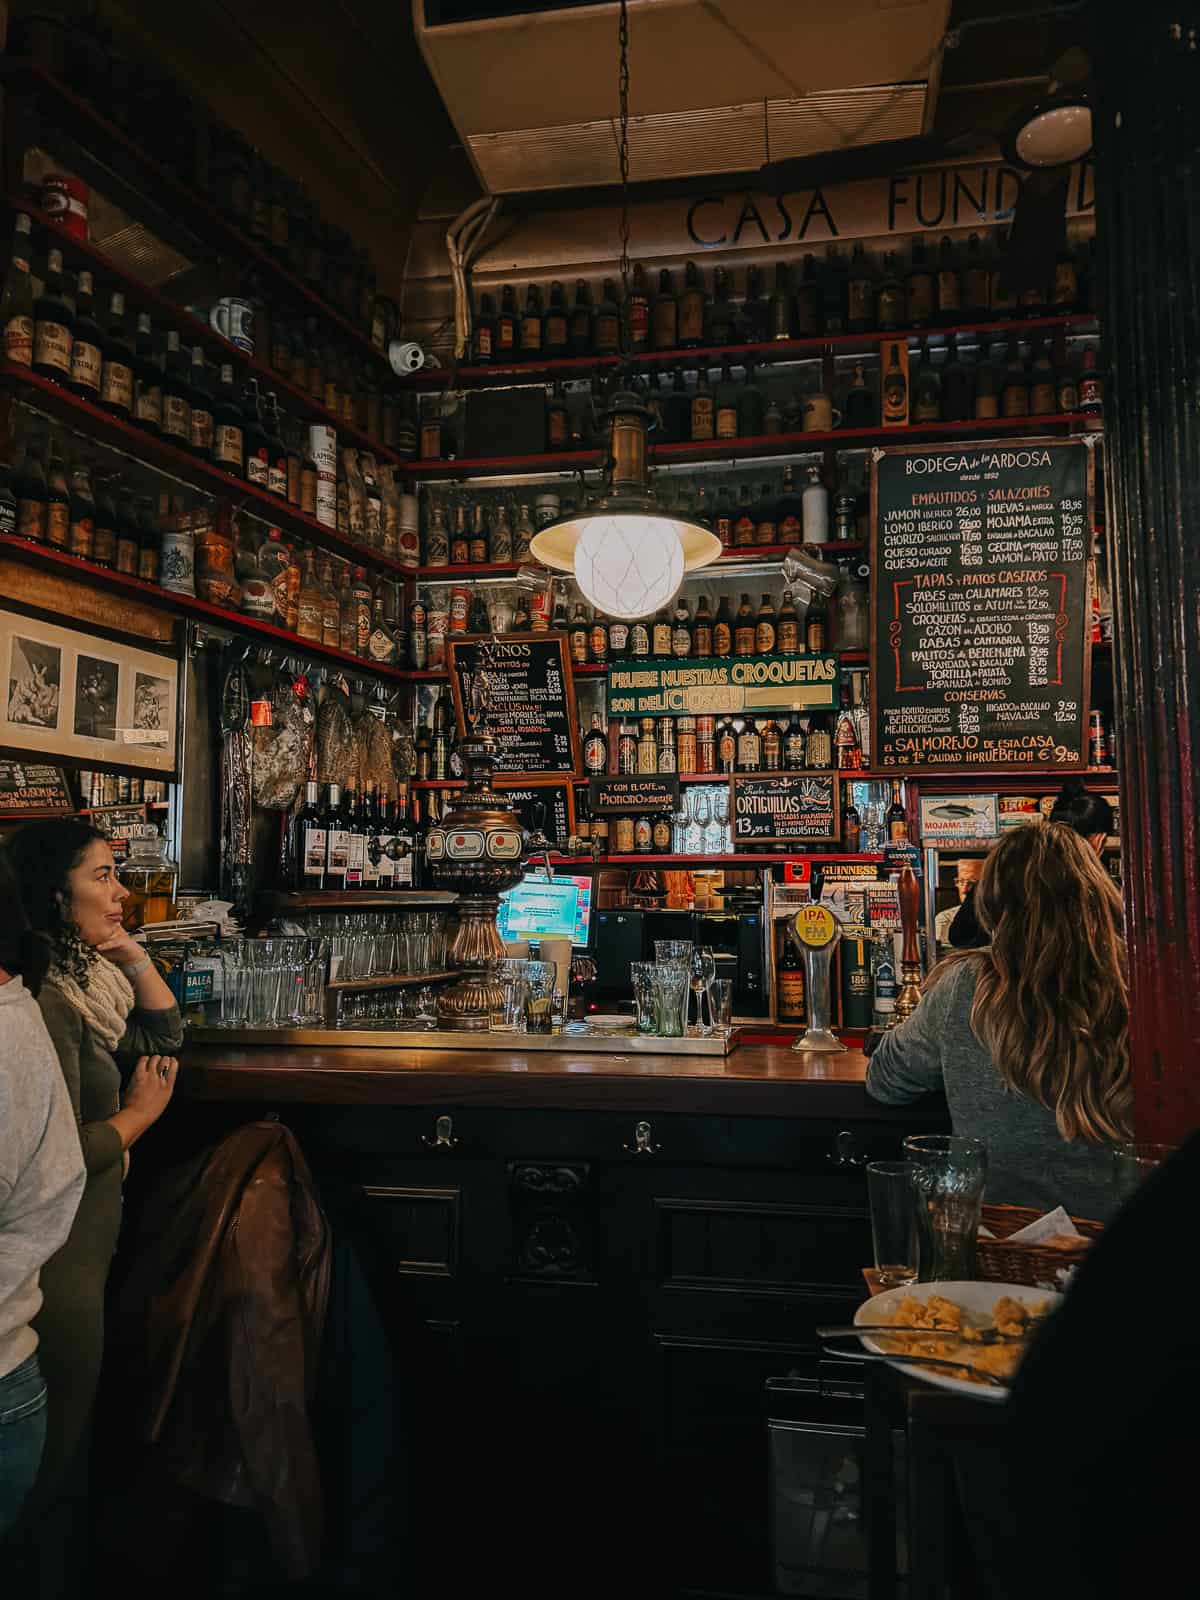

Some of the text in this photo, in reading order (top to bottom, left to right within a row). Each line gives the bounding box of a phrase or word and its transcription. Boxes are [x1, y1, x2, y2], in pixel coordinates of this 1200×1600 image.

[686, 187, 840, 248] CASA
[905, 456, 970, 475] BODEGA
[989, 451, 1053, 469] ARDOSA
[911, 490, 978, 506] EMBUTIDOS
[987, 485, 1051, 501] SALAZONES
[884, 509, 921, 521] JAMON
[986, 502, 1025, 515] HUEVAS
[884, 521, 915, 535] LOMO
[918, 519, 953, 532] IBERICO
[986, 515, 1033, 529] MOJAMA
[884, 533, 924, 546] CHORIZO
[1018, 527, 1055, 539] BACALAO
[884, 548, 918, 559] QUESO
[919, 546, 952, 557] CURADO
[987, 541, 1023, 553] CECINA
[884, 558, 920, 570] QUESO
[926, 557, 949, 567] ACEITE
[988, 551, 1024, 564] JAMON
[1032, 550, 1058, 562] PATO
[913, 573, 954, 588] TAPAS
[962, 574, 996, 586] PLATOS
[997, 570, 1048, 583] CASEROS
[912, 590, 947, 603] FABES
[965, 587, 1024, 600] CALAMARES
[905, 601, 971, 614] SOLOMILLITOS
[912, 613, 968, 626] CROQUETAS
[926, 624, 961, 636] CAZON
[973, 622, 1012, 635] ADOBO
[919, 636, 961, 649] RABAS
[974, 635, 1024, 646] CANTABRIA
[911, 650, 956, 662] PALITOS
[968, 646, 1026, 659] BERENJENA
[922, 660, 971, 671] BRANDADA
[979, 657, 1014, 668] BACALAO
[611, 659, 837, 689] PRUEBE NUESTRAS CROQUETAS
[929, 669, 972, 681] TORTILLA
[977, 667, 1006, 677] PATATA
[926, 678, 974, 689] EMPANADA
[943, 689, 1007, 702] CONSERVAS
[611, 697, 635, 712] SON
[1020, 701, 1051, 711] BACALAO
[996, 711, 1040, 721] NAVAJAS
[884, 725, 934, 736] MEJILLONES
[895, 735, 979, 753] SALMOREJO
[997, 738, 1021, 749] ESTA
[1021, 735, 1056, 749] CASA
[927, 752, 962, 764] CALIDAD
[613, 784, 629, 792] CON
[506, 791, 532, 801] TAPAS
[736, 796, 801, 814] ORTIGUILLAS
[924, 821, 962, 830] MOJAMA
[822, 864, 878, 875] GUINNESS
[804, 910, 826, 921] IPA
